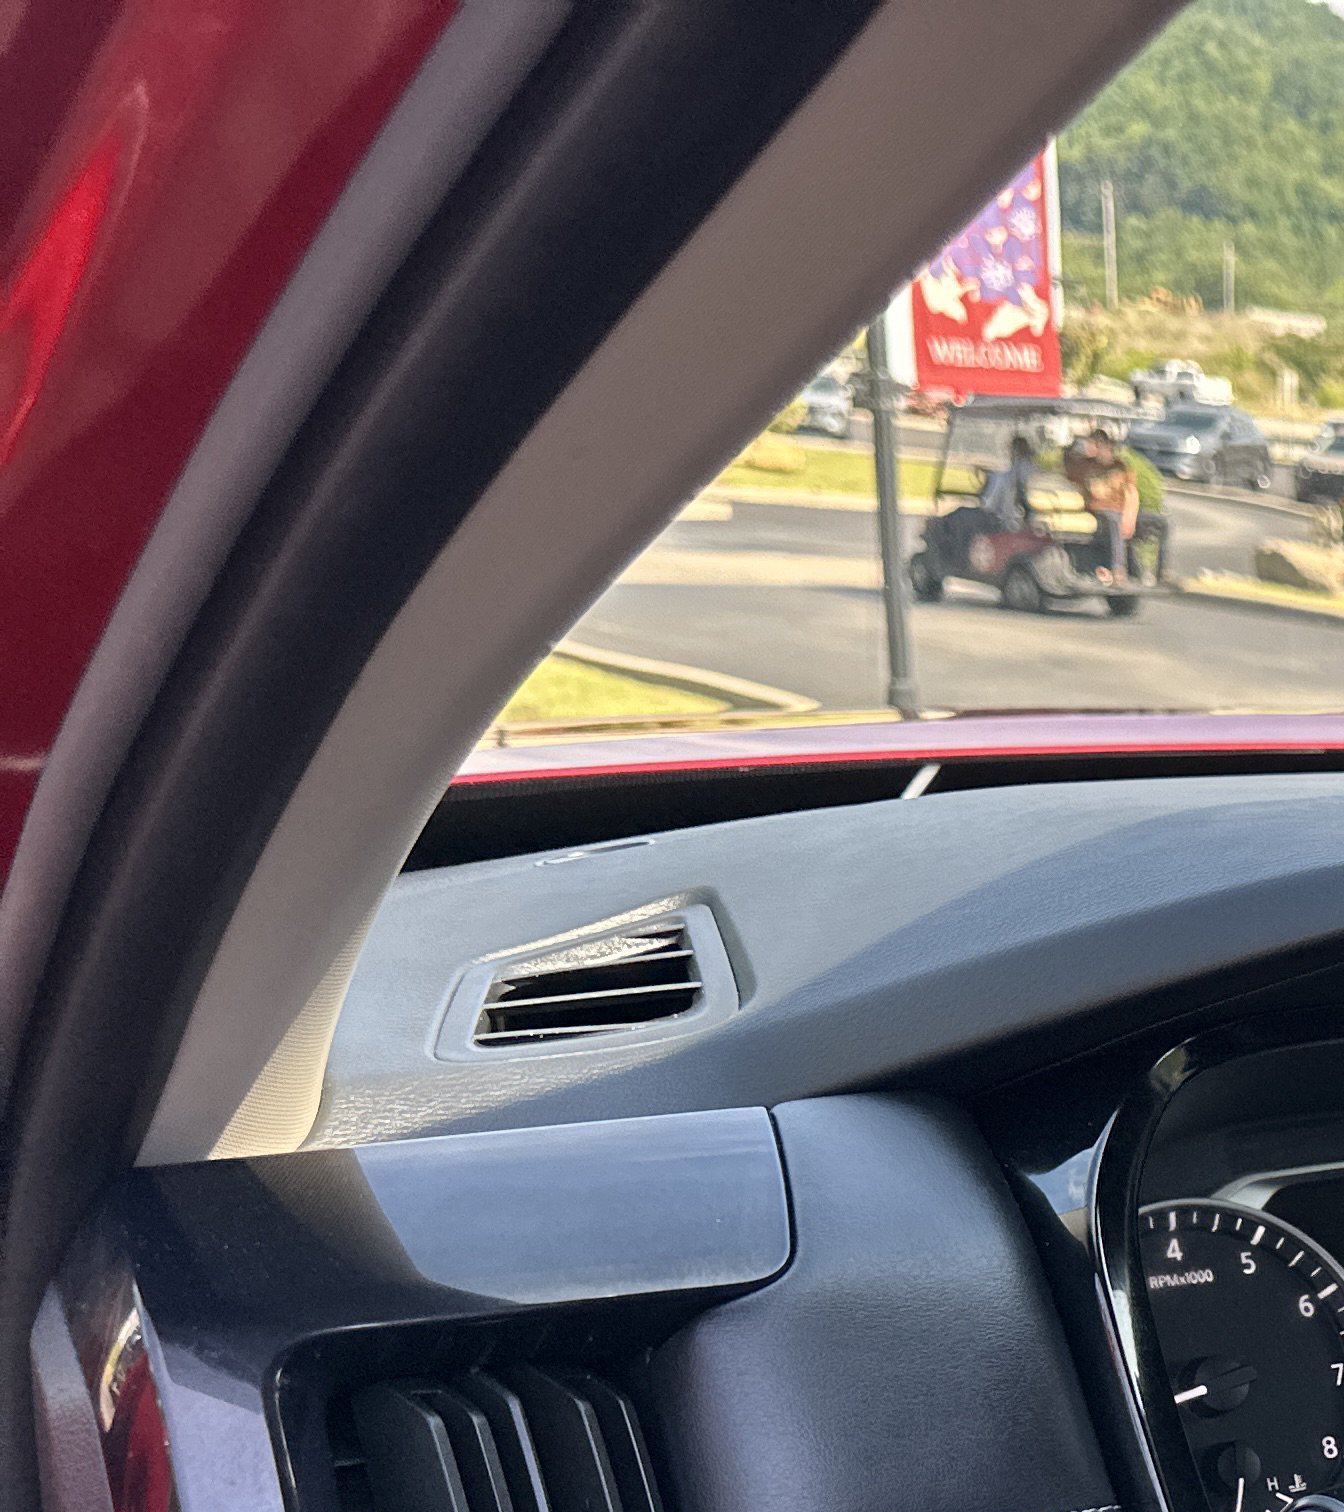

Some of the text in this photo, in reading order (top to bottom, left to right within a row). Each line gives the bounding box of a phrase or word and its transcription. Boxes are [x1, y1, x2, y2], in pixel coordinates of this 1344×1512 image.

[1166, 1239, 1183, 1262] 4
[1240, 1252, 1256, 1275] 5
[1298, 1295, 1315, 1317] 6
[1330, 1362, 1344, 1386] 7
[1322, 1435, 1339, 1459] 8
[1266, 1477, 1280, 1491] H
